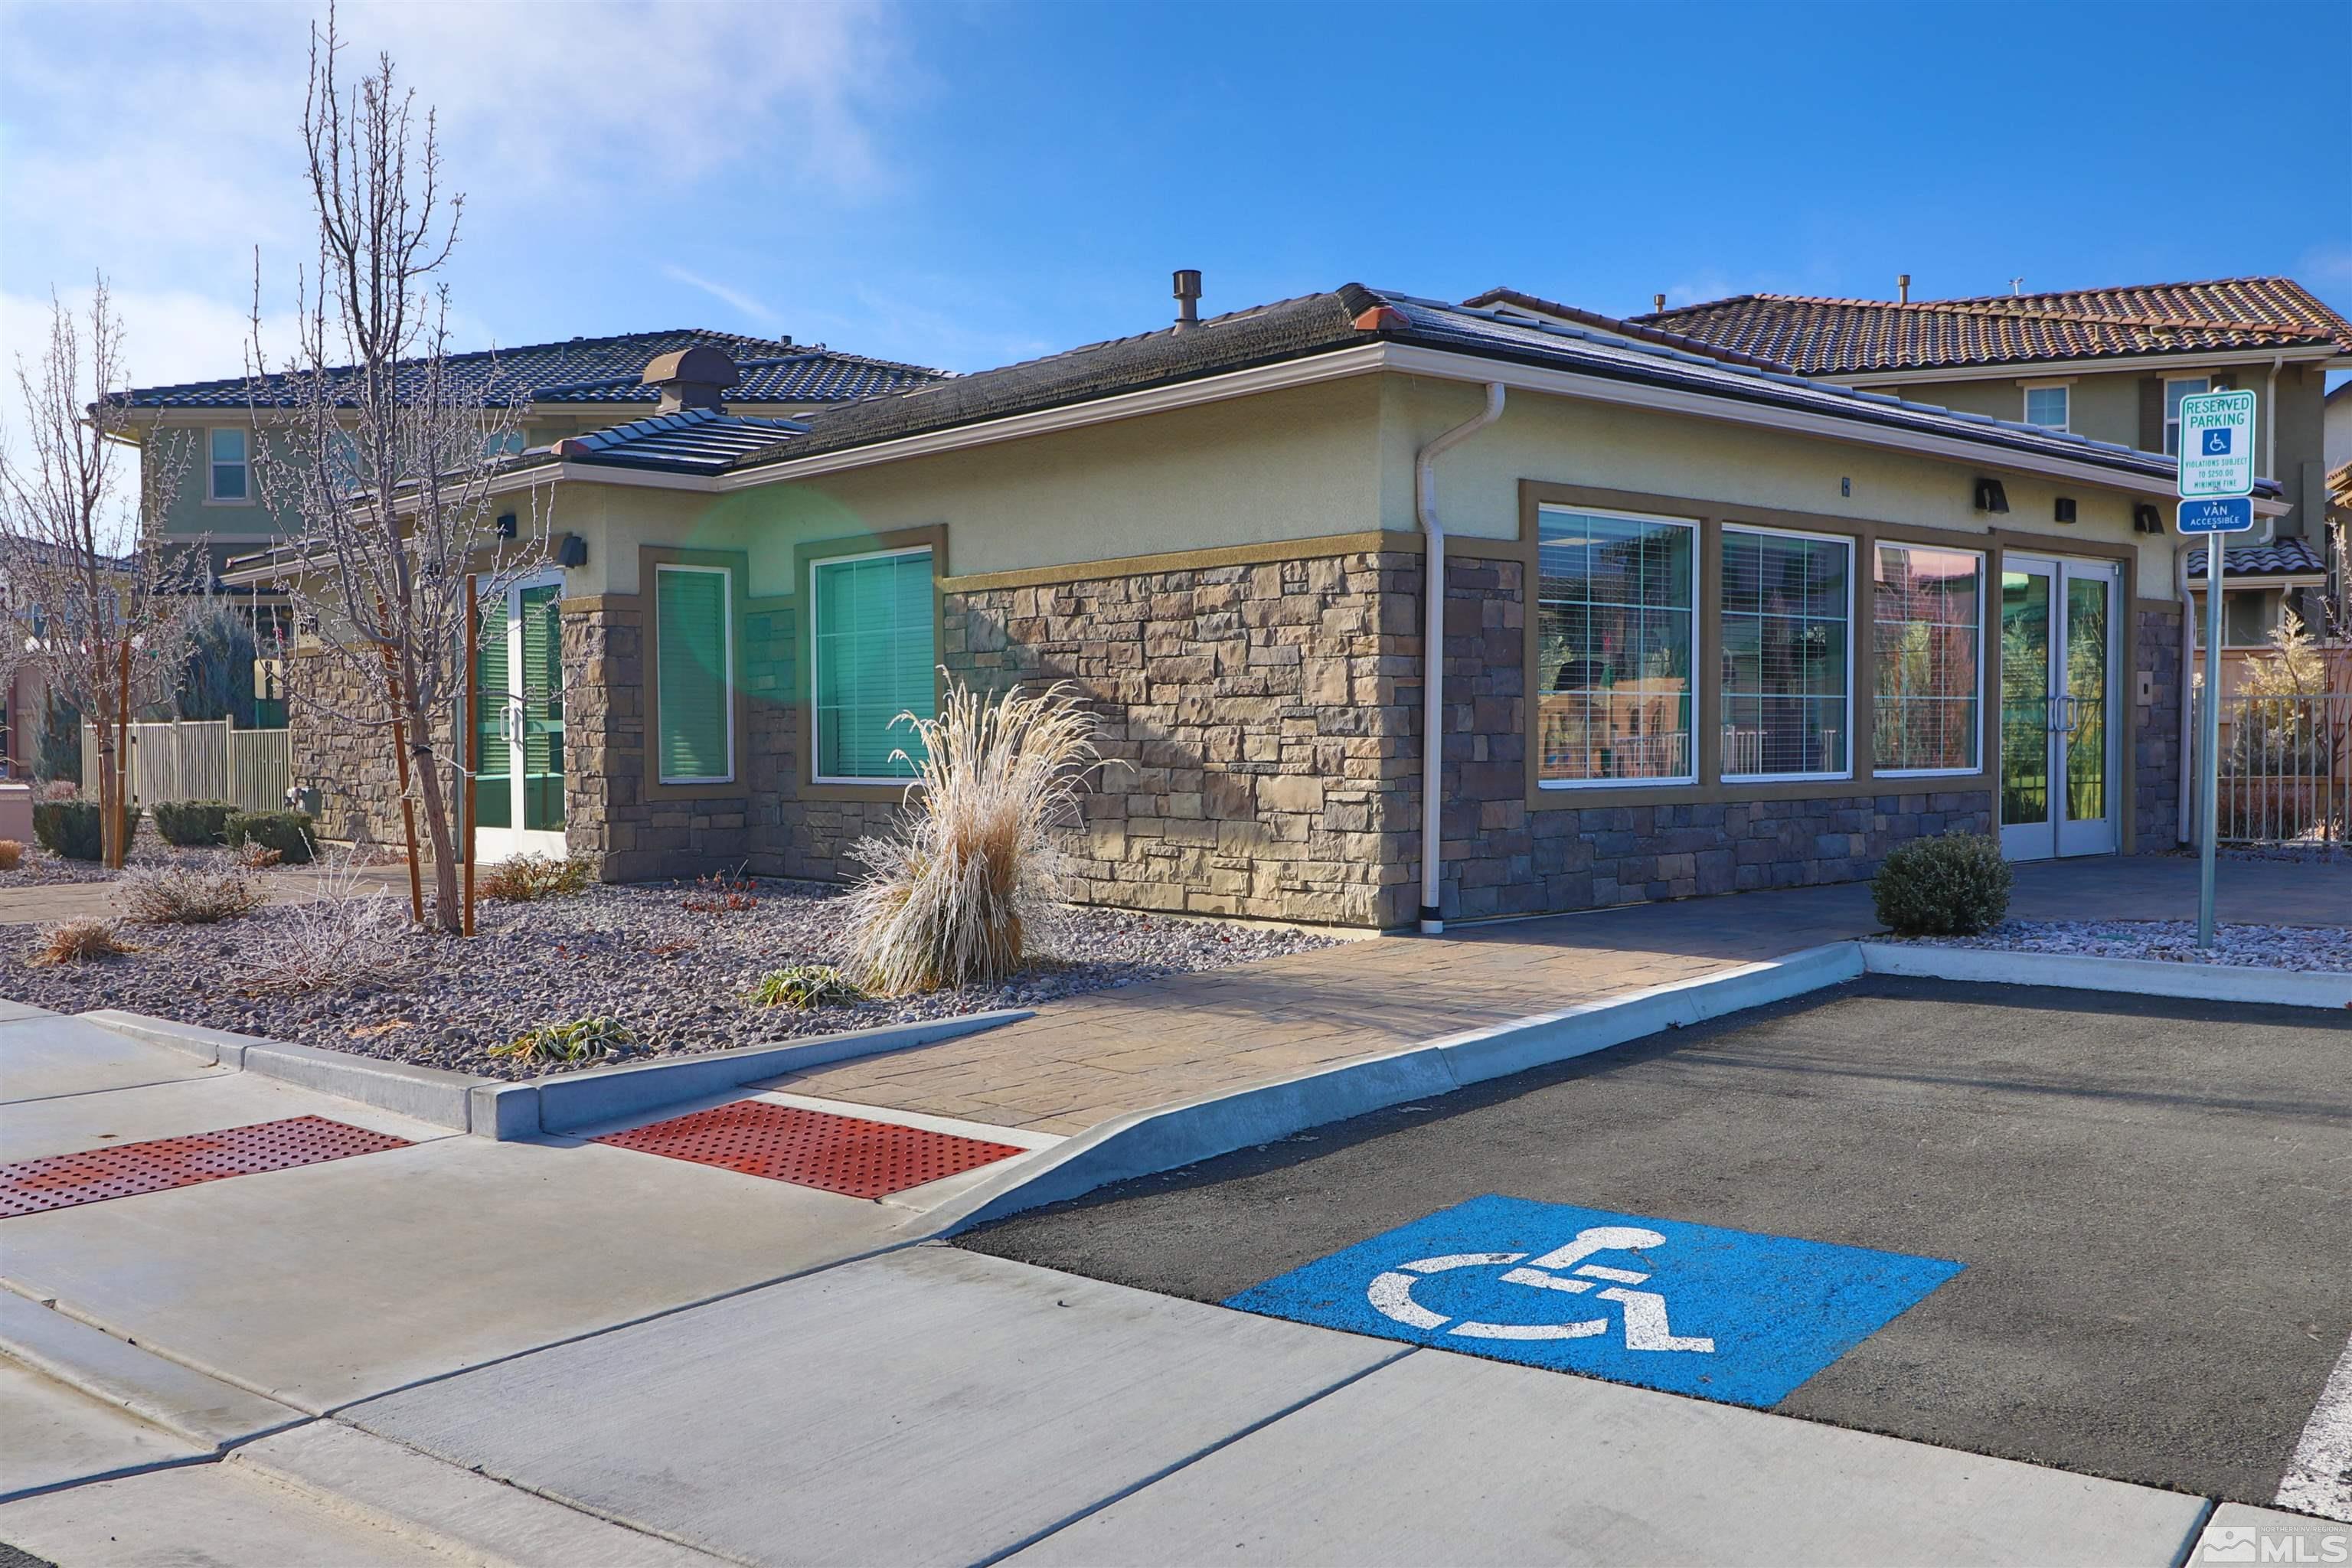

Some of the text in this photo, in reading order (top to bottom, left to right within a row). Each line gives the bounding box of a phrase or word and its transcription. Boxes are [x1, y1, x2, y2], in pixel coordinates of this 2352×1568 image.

[2187, 397, 2249, 415] RESERVED
[2190, 413, 2245, 429] PARKING
[2185, 457, 2248, 469] VIOLATIONS SUBJECT
[2207, 469, 2234, 479] $250.00
[2203, 505, 2227, 516] VAN
[2190, 516, 2240, 527] ACCESSIBLE
